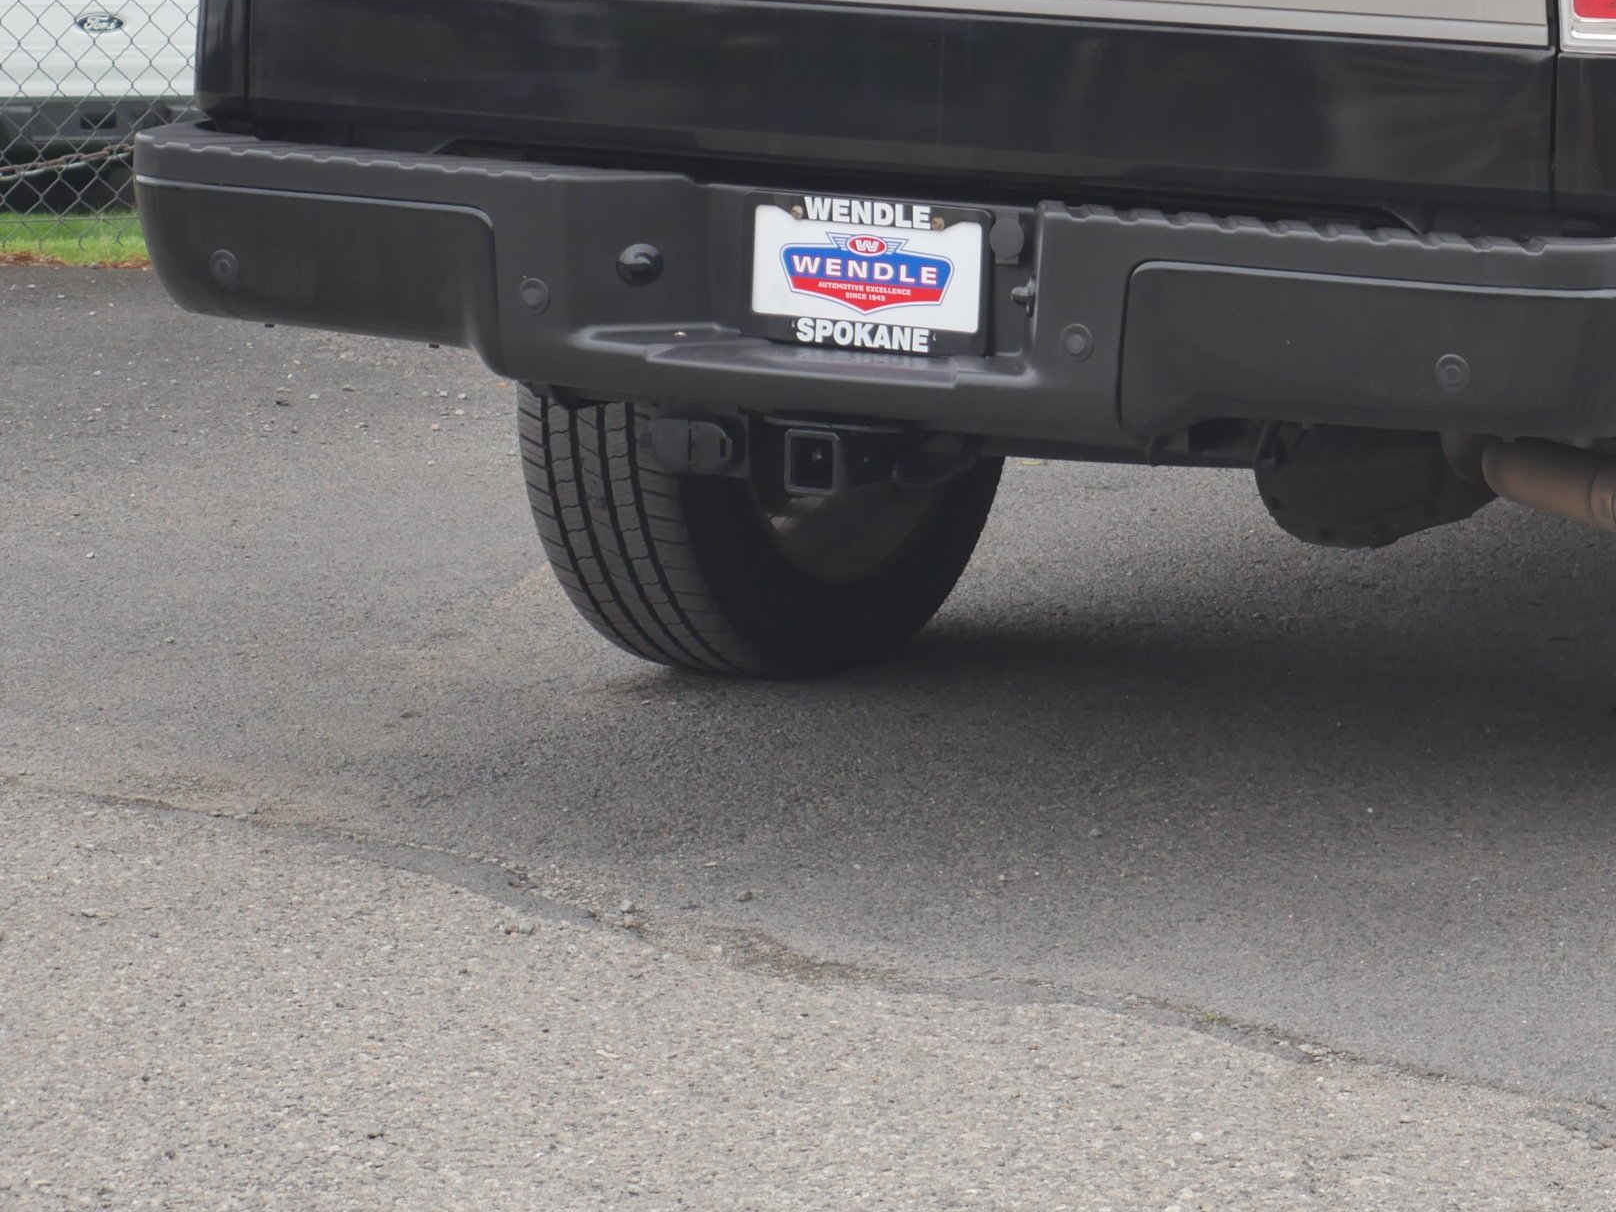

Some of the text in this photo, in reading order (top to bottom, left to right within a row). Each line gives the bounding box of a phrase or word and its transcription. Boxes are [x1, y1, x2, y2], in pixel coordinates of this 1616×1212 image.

[804, 196, 931, 230] WENDLE
[792, 255, 938, 285] WENDLE
[817, 281, 911, 296] AUTOMOTIVE EXCELLENCE
[845, 291, 867, 300] SINCE
[796, 317, 929, 353] SPOKANE
